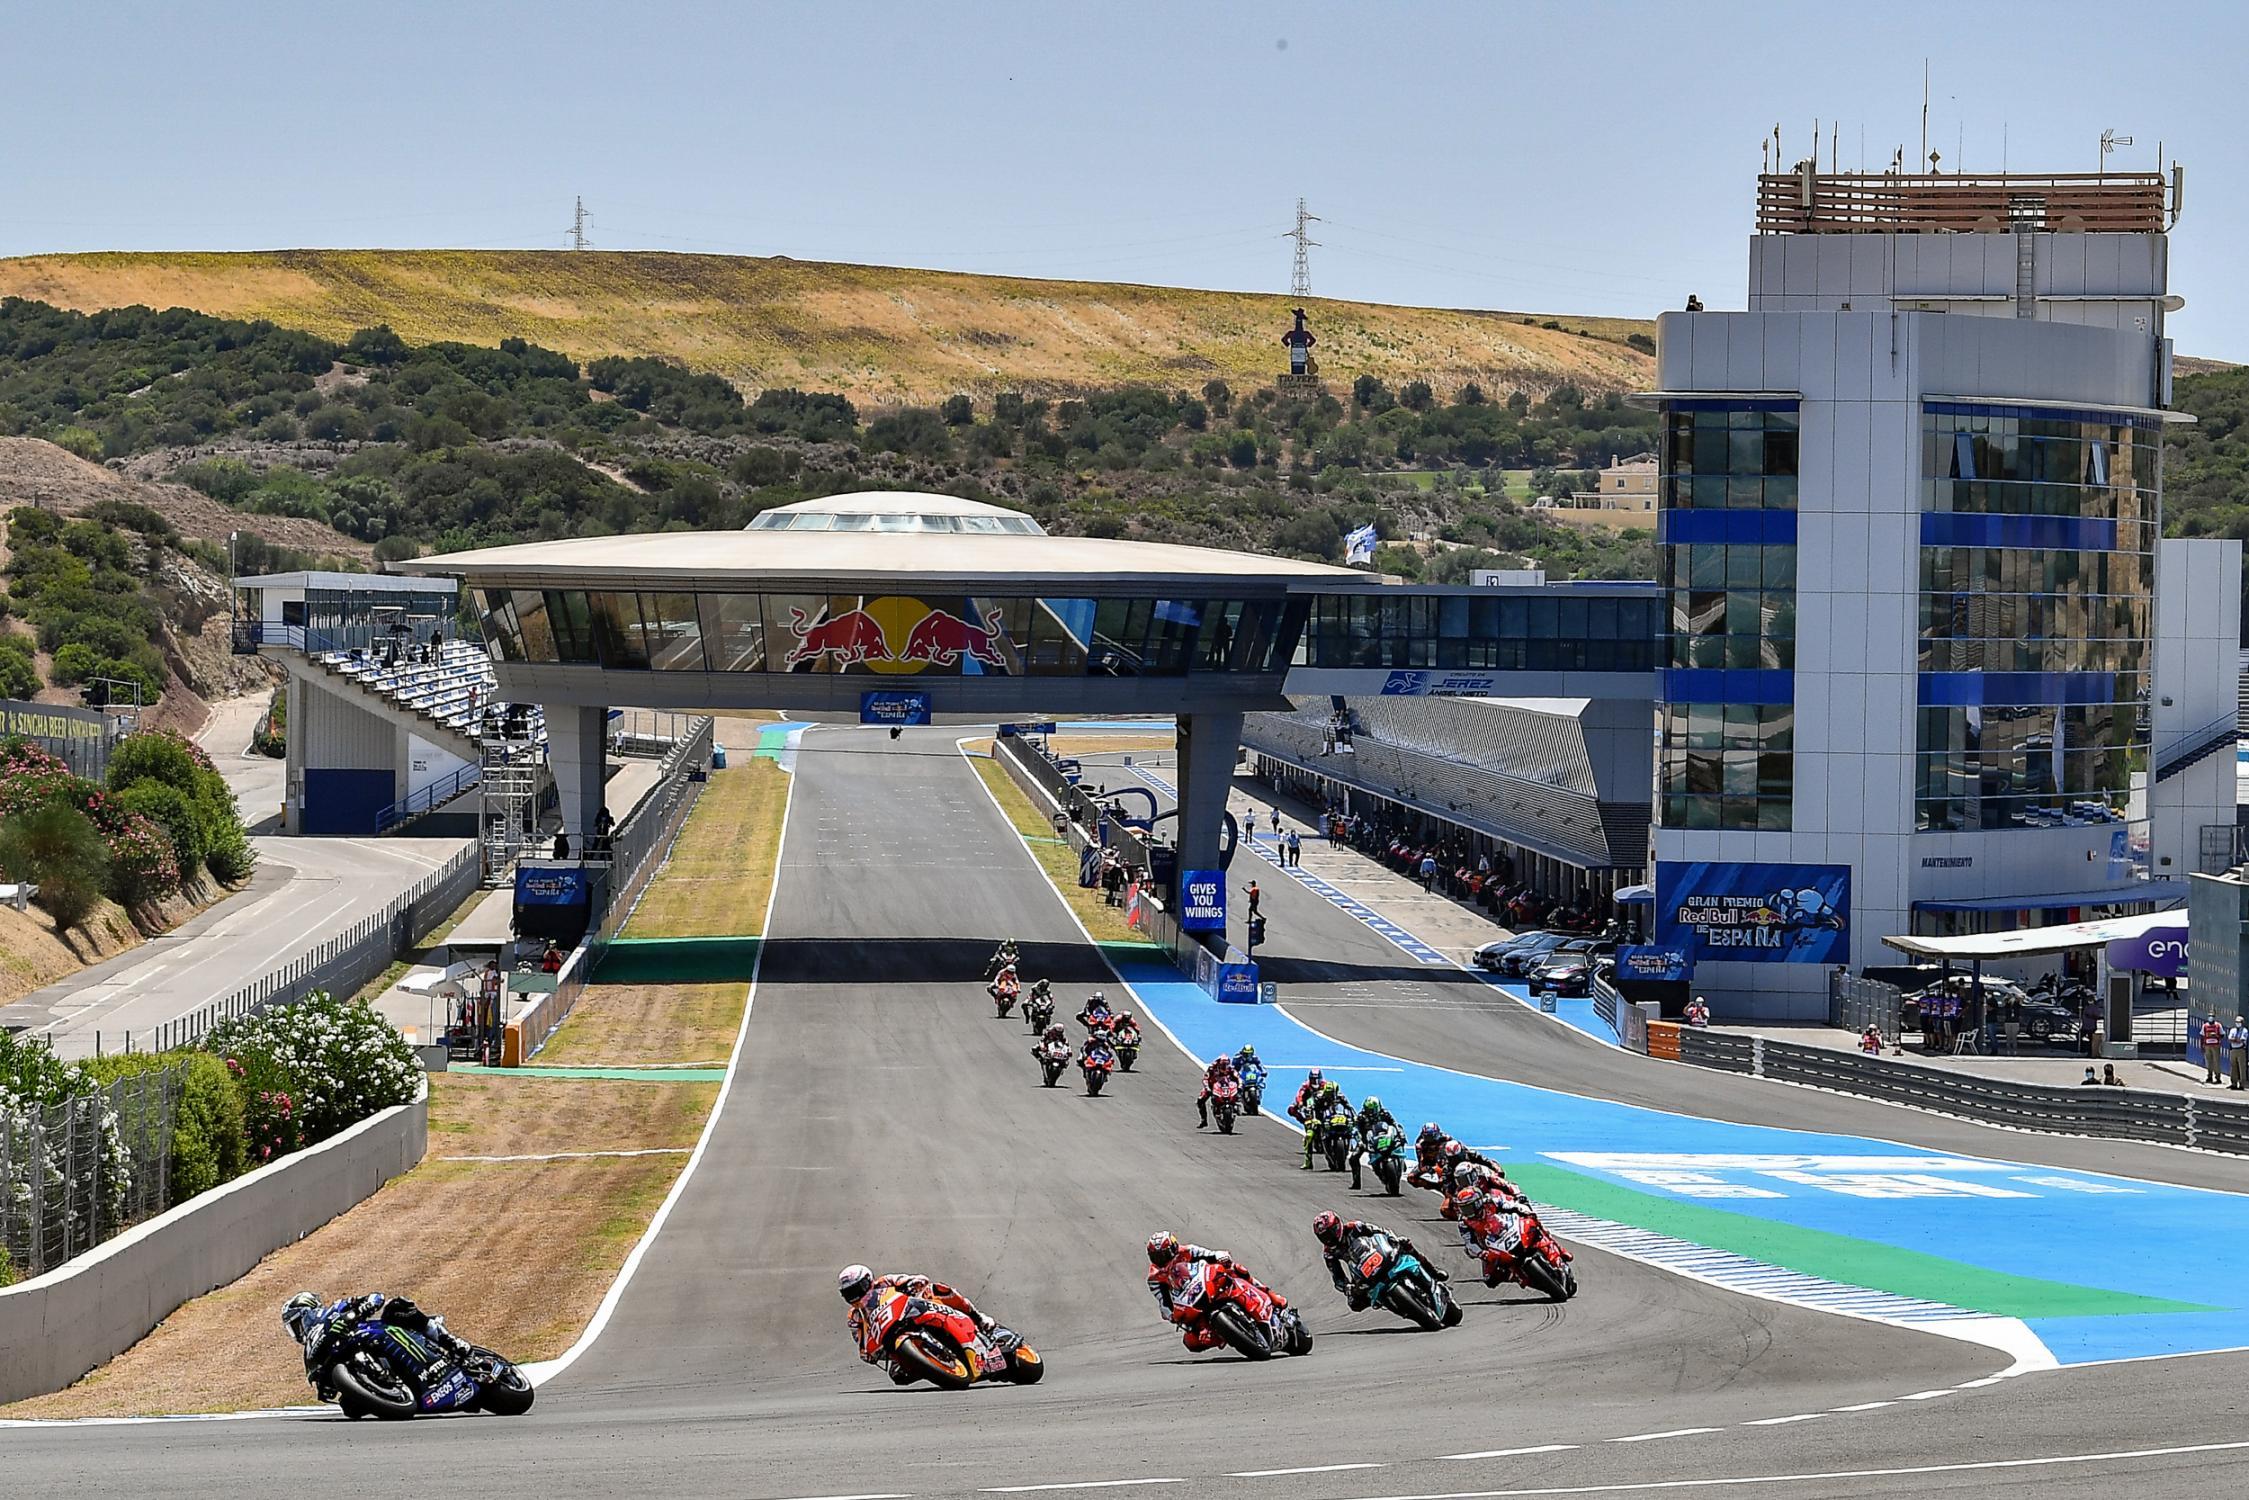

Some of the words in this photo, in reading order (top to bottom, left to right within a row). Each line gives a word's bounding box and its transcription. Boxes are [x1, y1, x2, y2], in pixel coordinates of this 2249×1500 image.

[1432, 678, 1494, 688] JEREZ
[17, 712, 49, 737] SINGHA
[49, 716, 67, 738] BEER
[1921, 856, 1973, 868] MANTENIMIENTO
[1190, 883, 1216, 895] GIVES
[1193, 895, 1213, 906] YOU
[1688, 896, 1719, 907] GRAN
[1723, 897, 1764, 907] PREMIO
[1679, 907, 1708, 923] Red
[1709, 908, 1738, 924] Bull
[1697, 924, 1709, 934] DE
[1709, 926, 1782, 947] ESPAÑA
[1377, 1137, 1391, 1149] 21
[1504, 1231, 1520, 1251] 63
[871, 1305, 893, 1345] 93
[431, 1381, 453, 1403] ENEOS
